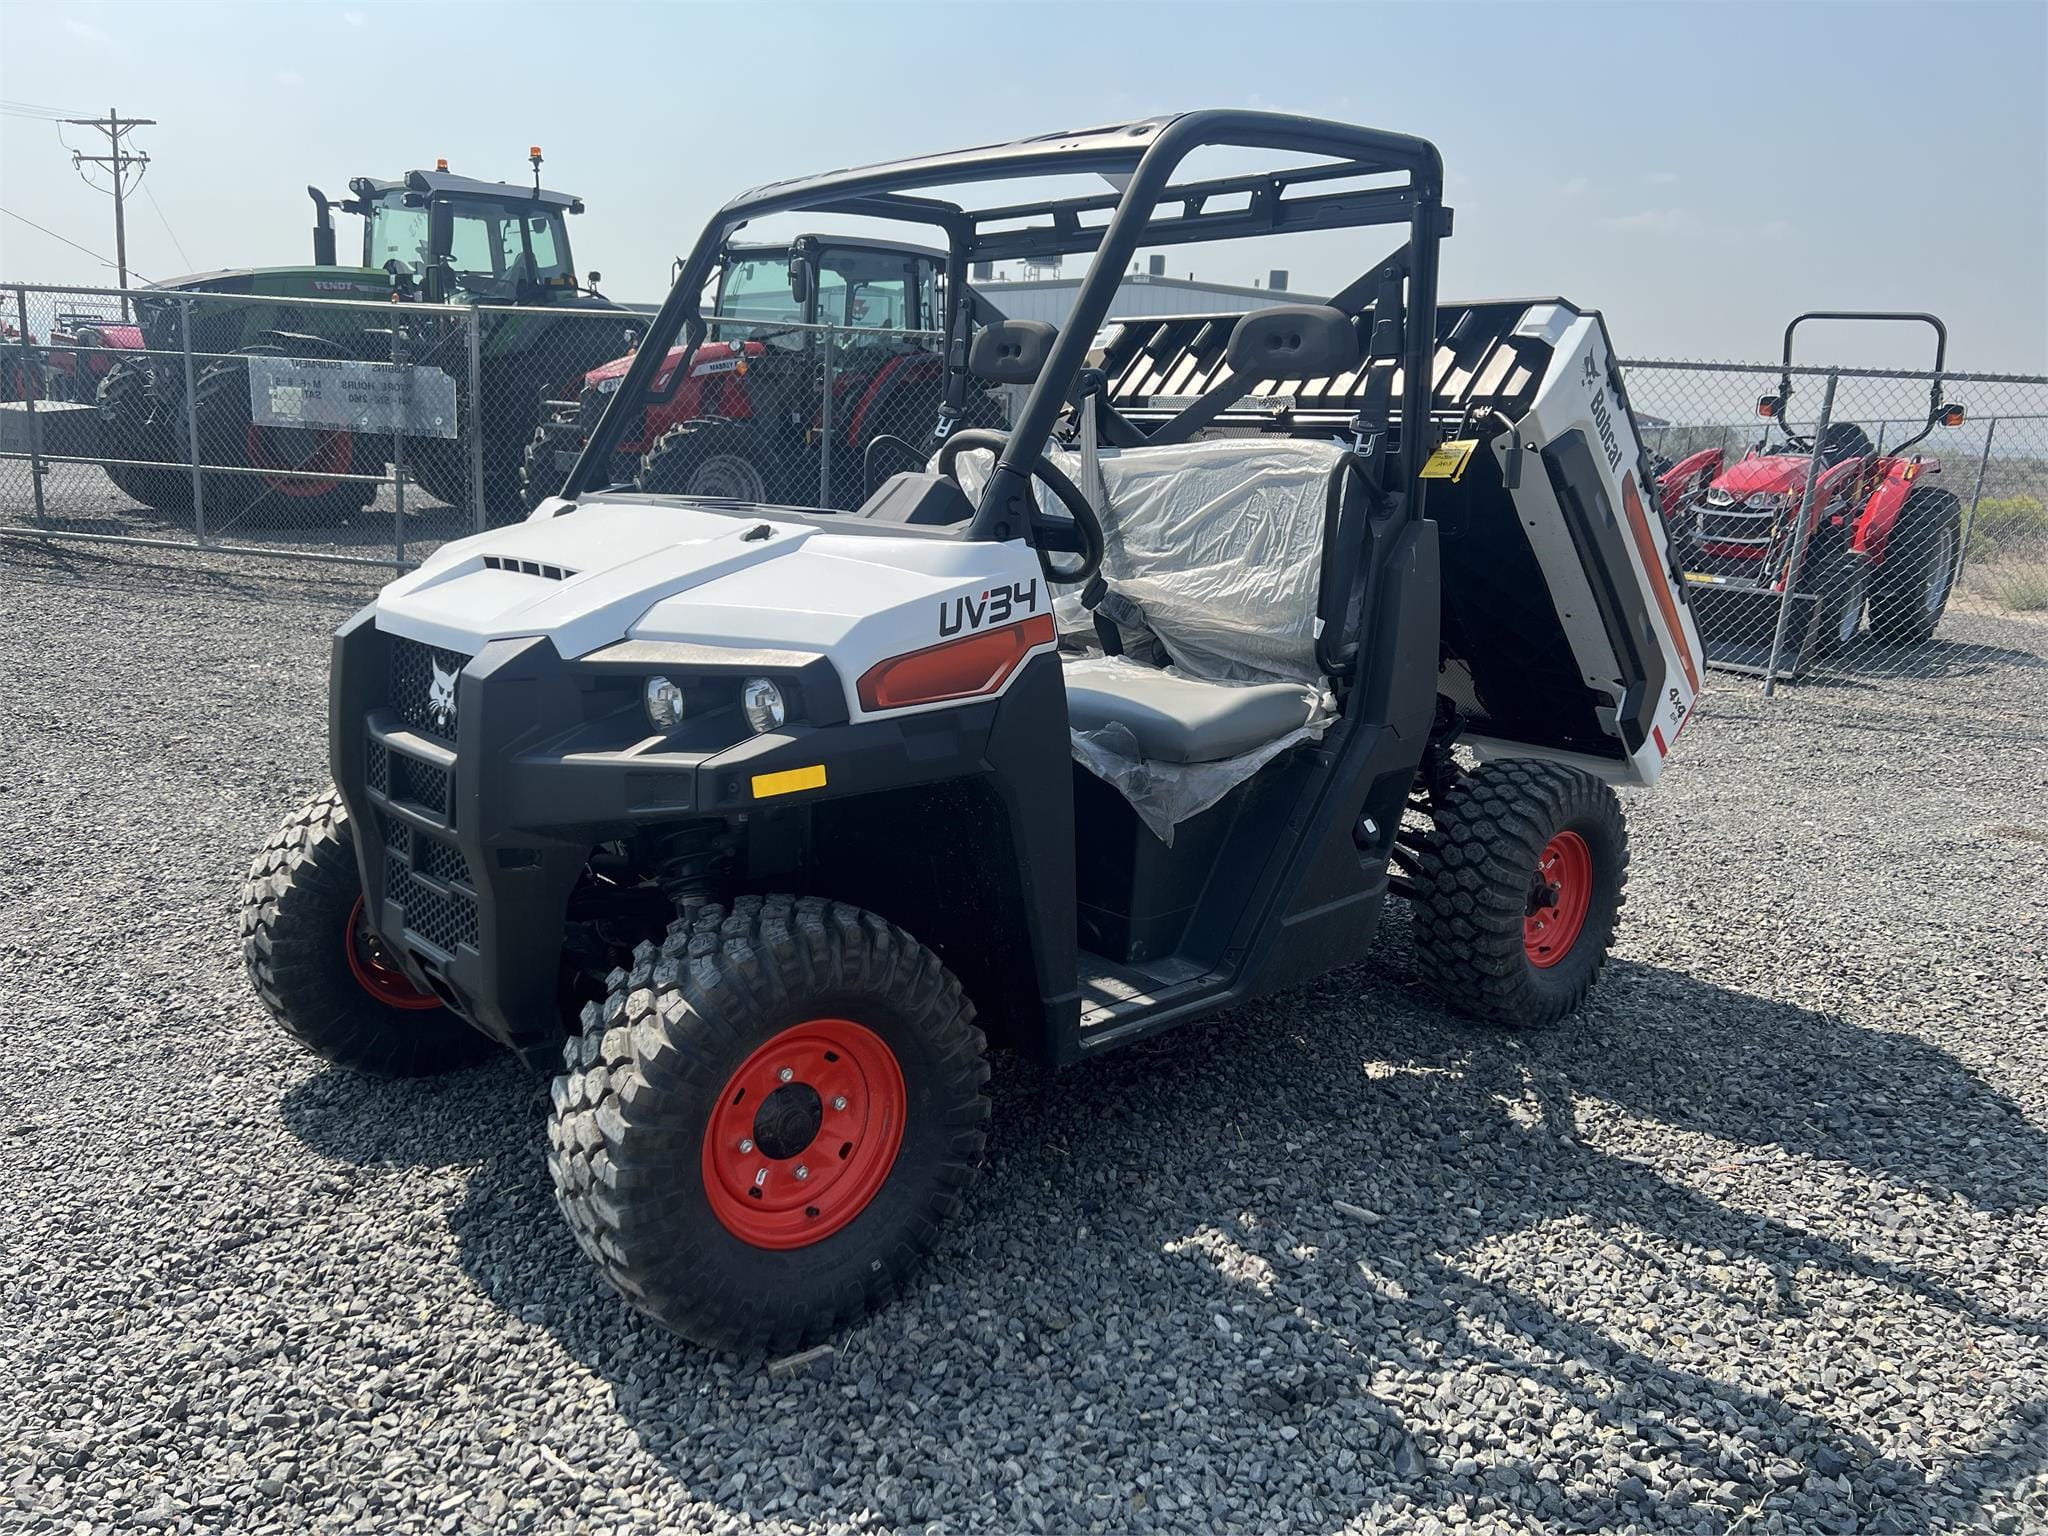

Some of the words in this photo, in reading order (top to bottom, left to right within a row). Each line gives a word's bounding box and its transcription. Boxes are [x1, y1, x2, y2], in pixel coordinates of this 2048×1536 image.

[313, 281, 353, 290] FENDT
[710, 361, 733, 370] MASSEY
[1590, 386, 1623, 474] Bobcat
[939, 578, 1036, 637] UV34
